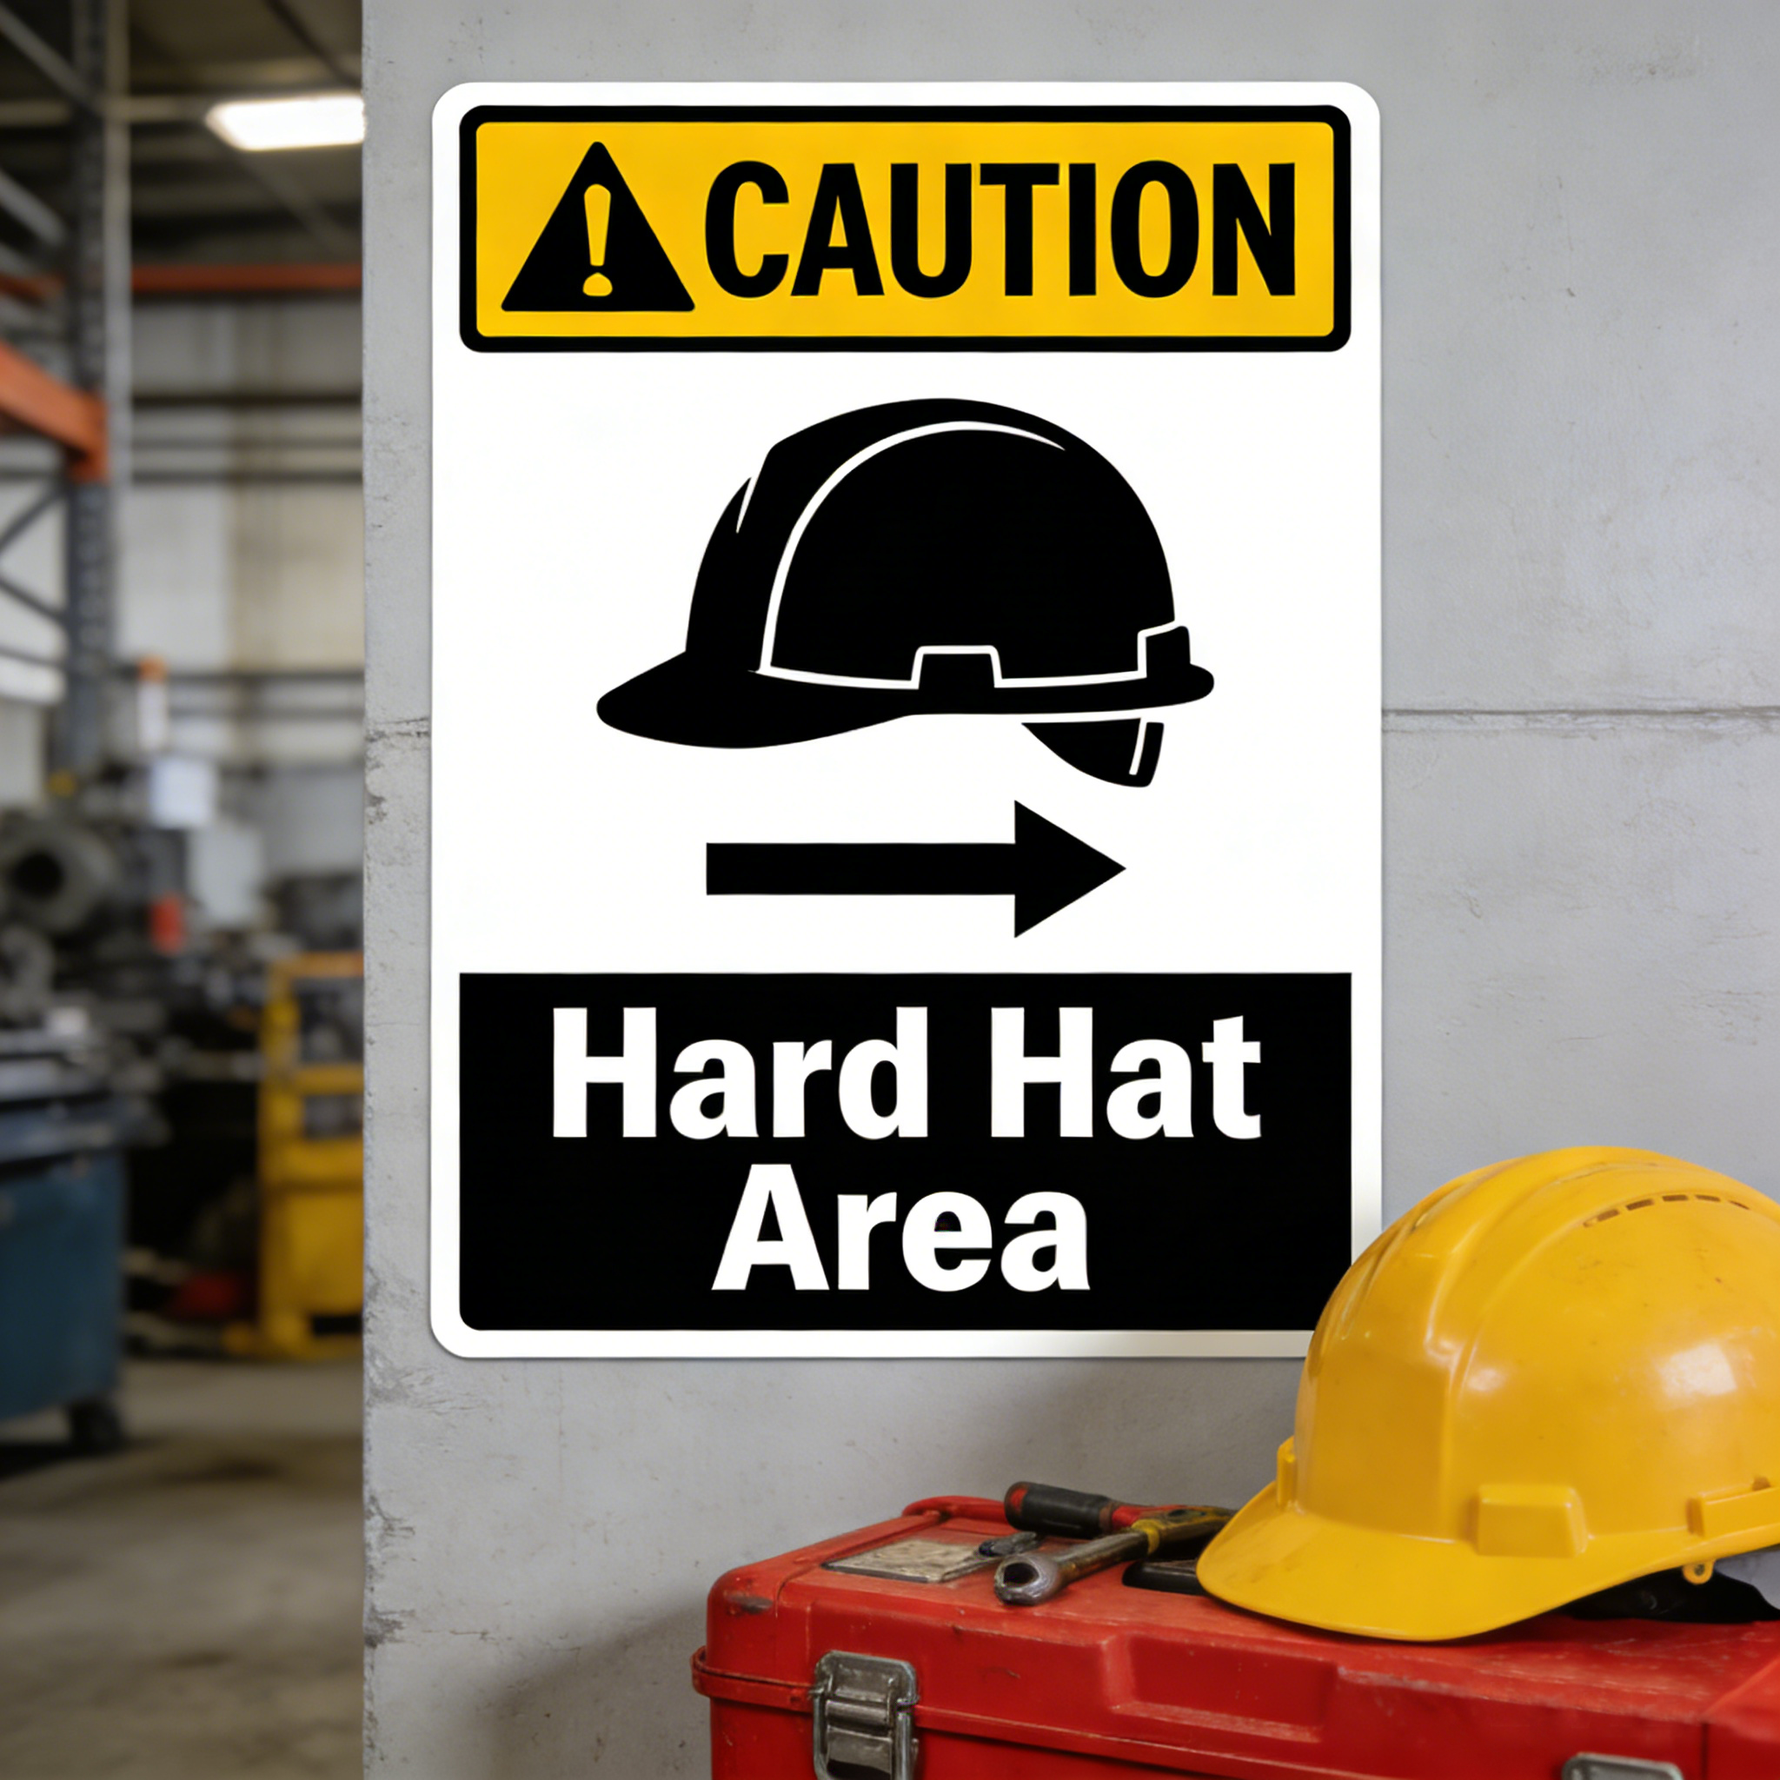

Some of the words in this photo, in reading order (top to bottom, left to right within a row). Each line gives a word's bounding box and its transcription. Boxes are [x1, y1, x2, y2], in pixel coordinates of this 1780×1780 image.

[705, 160, 1295, 298] CAUTION
[552, 1006, 928, 1140] Hard
[991, 1006, 1261, 1140] Hat
[712, 1164, 1090, 1292] Area
